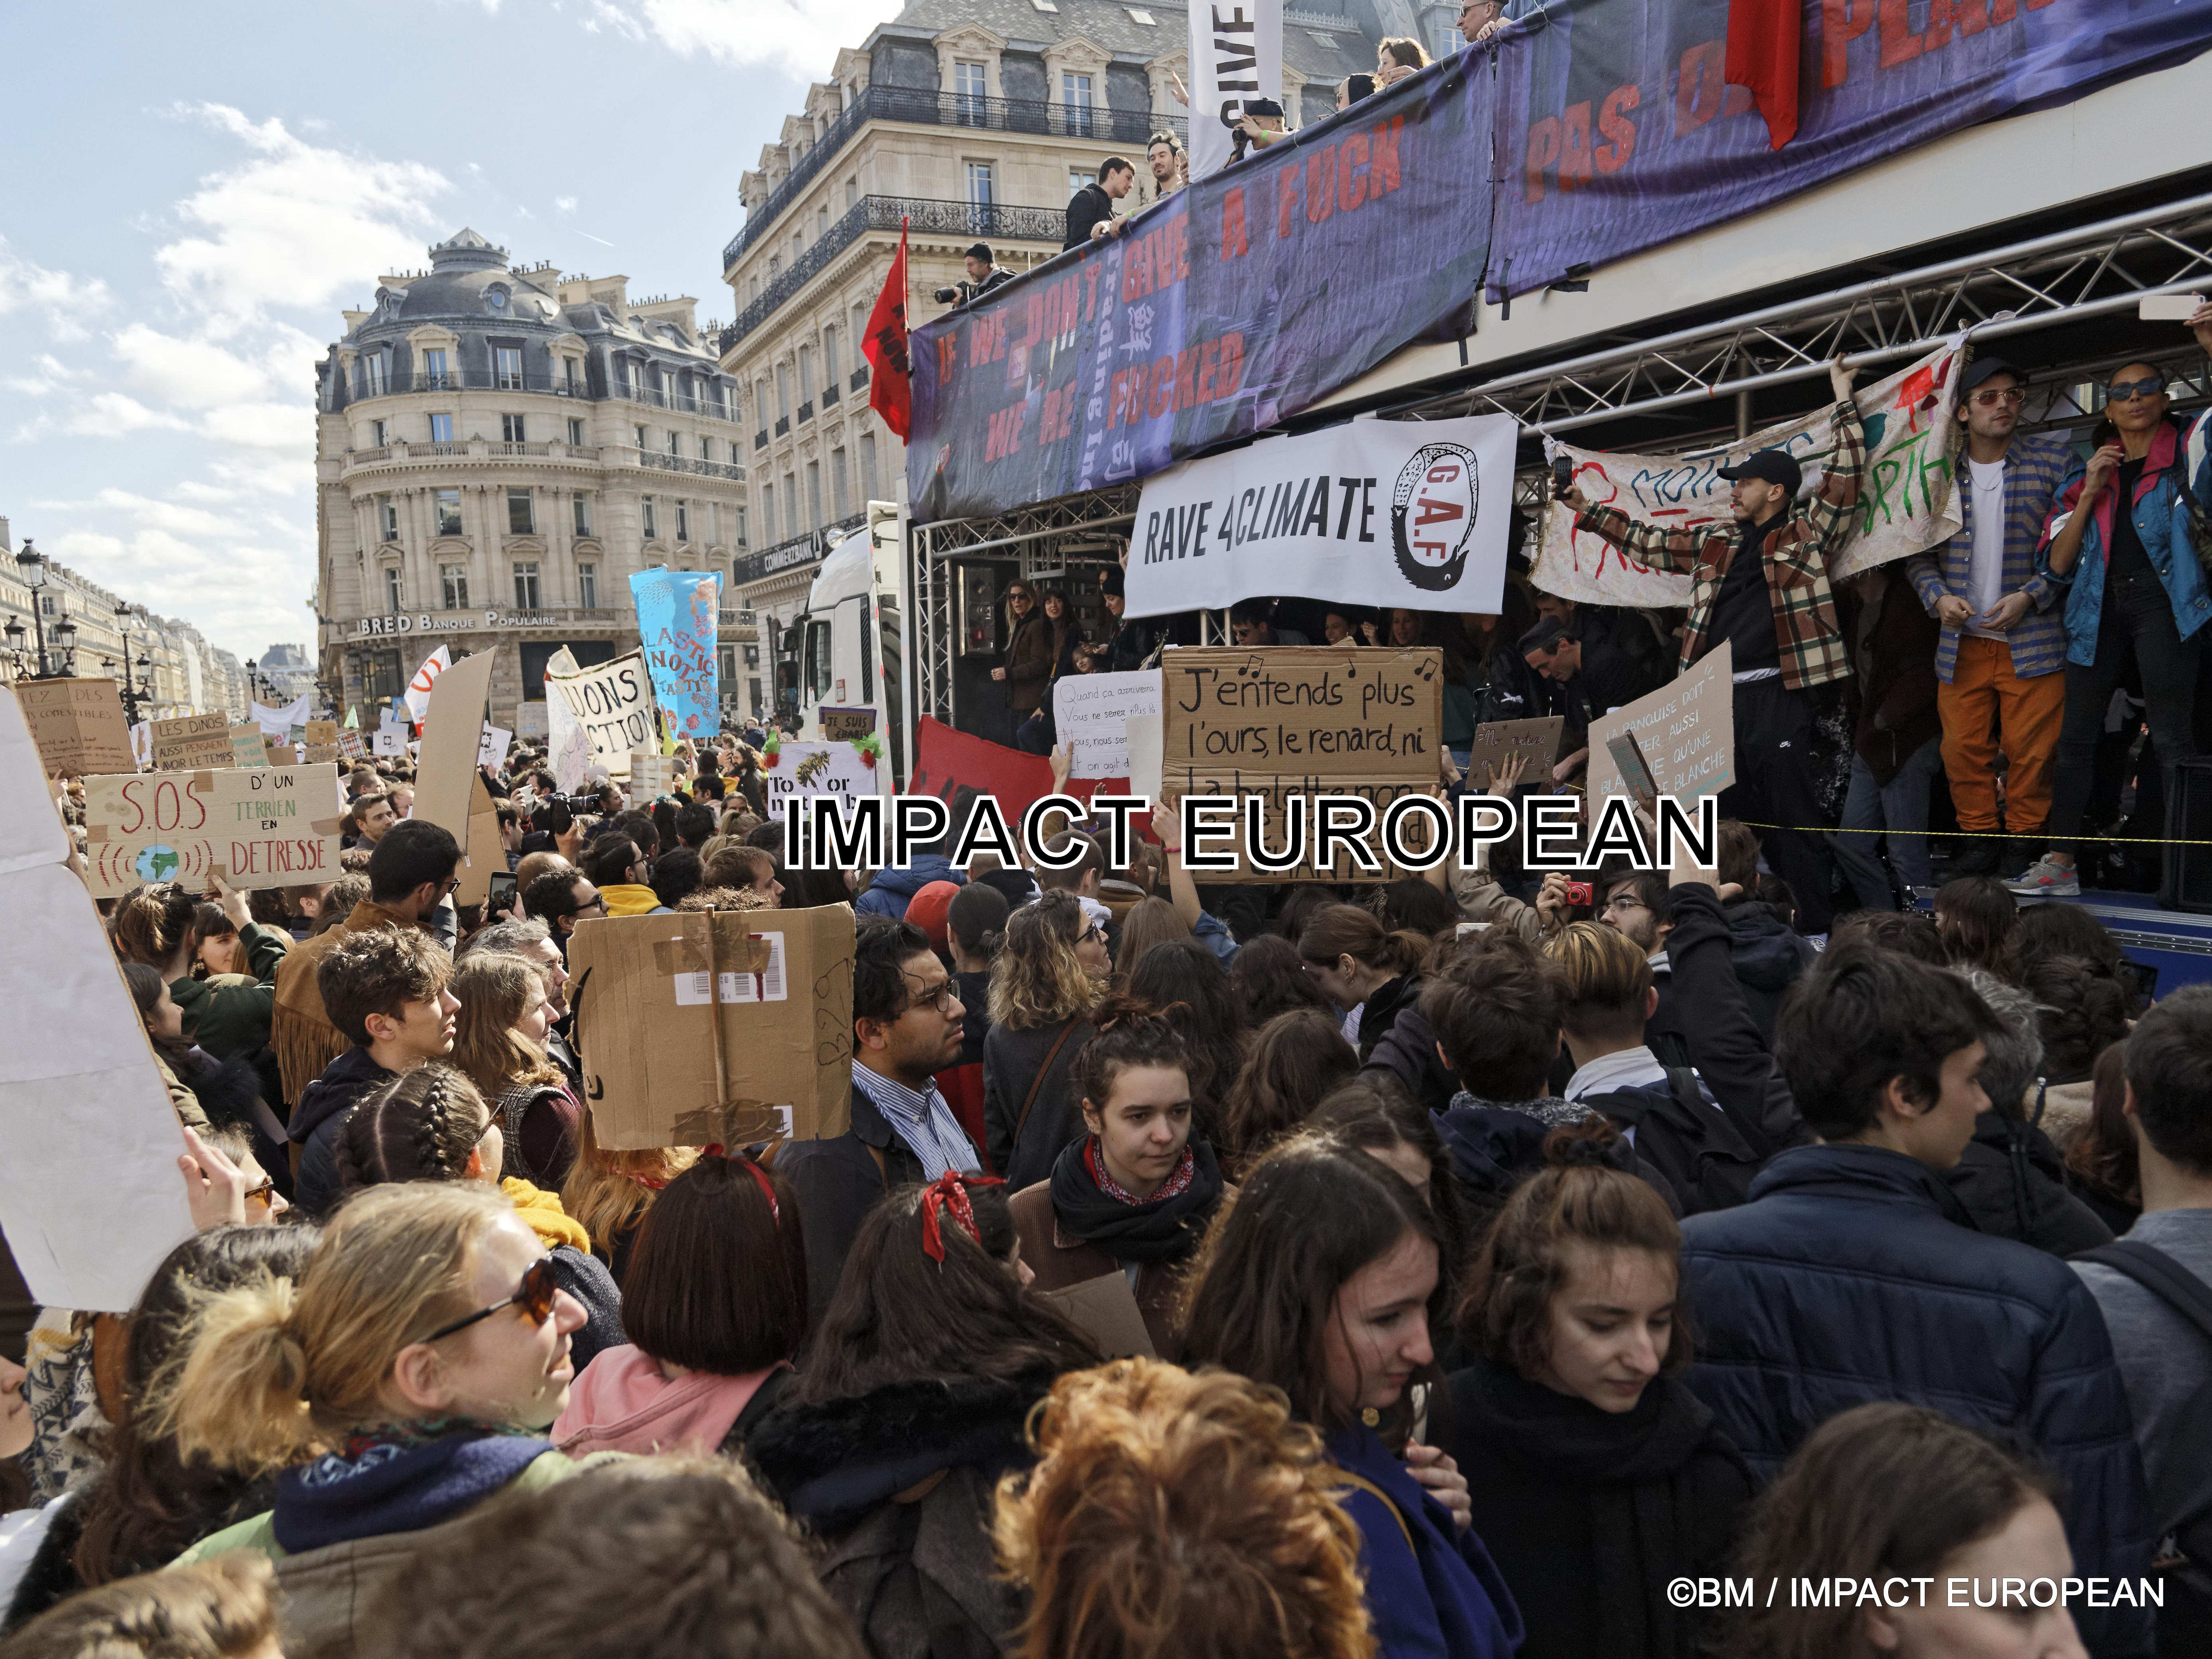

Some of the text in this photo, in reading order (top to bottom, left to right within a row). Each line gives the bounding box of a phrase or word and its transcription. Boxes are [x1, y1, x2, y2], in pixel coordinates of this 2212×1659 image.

[1526, 85, 1640, 205] PAS
[1675, 40, 1759, 138] D
[938, 114, 1404, 387] IF WE DON'T GIVE A FUCK
[1086, 239, 1123, 422] Trading
[1107, 331, 1244, 431] FUCKED
[1144, 476, 1377, 565] RAVE 4CLIMATE
[764, 540, 813, 572] COMMERZBANK
[360, 615, 412, 635] BRED
[650, 650, 695, 681] NOT
[75, 689, 102, 701] DES
[1060, 684, 1156, 705] Quand ça arrivera
[1179, 668, 1416, 720] J'entends plus
[1623, 699, 1677, 734] BANQUISE
[1682, 680, 1705, 706] DOIT
[40, 709, 112, 719] COMESTIBLES
[827, 715, 867, 728] JE SUIS
[1062, 706, 1088, 721] Vous
[1104, 709, 1126, 721] serez
[1668, 709, 1699, 741] AUSSI
[159, 717, 224, 737] LES DINOS
[579, 704, 652, 753] CTION
[1063, 728, 1092, 748] Nous,
[1189, 720, 1427, 759] l'ours, le renard, ni
[1485, 729, 1546, 746] No nature
[186, 739, 227, 753] PENSAIENT
[1674, 729, 1711, 763] QU'UNE
[162, 758, 186, 770] AVOIR
[189, 756, 202, 767] LE
[203, 752, 234, 764] TEMPS
[1103, 757, 1120, 773] agit
[1674, 747, 1725, 792] BLANCHE
[770, 777, 850, 792] To or
[235, 799, 296, 821] TERRIEN
[772, 796, 808, 811] nt
[1355, 784, 1414, 814] non
[262, 820, 277, 830] EN
[231, 839, 326, 875] DETRESSE
